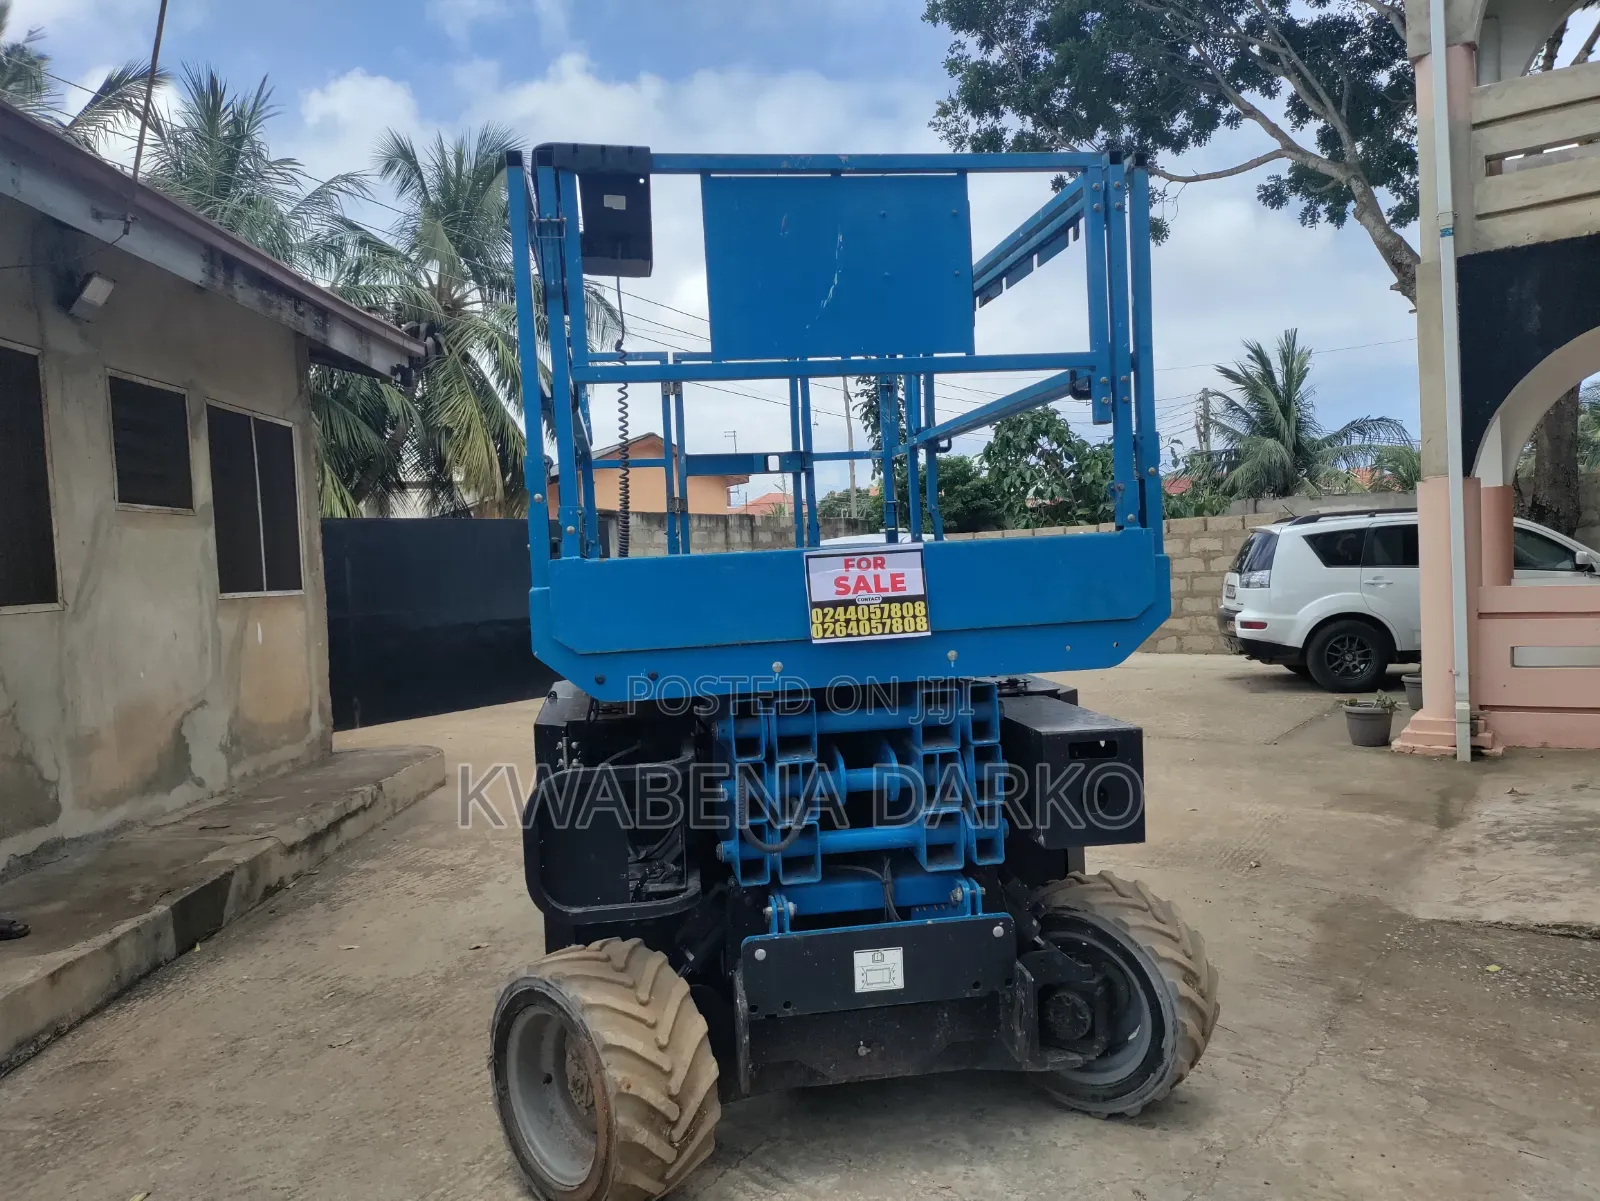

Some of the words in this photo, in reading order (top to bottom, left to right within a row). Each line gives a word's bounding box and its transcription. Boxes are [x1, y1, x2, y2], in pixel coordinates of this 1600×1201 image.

[843, 556, 886, 572] FOR
[834, 572, 907, 596] SALE
[811, 601, 926, 624] 0244057808
[812, 616, 928, 639] 0264057808
